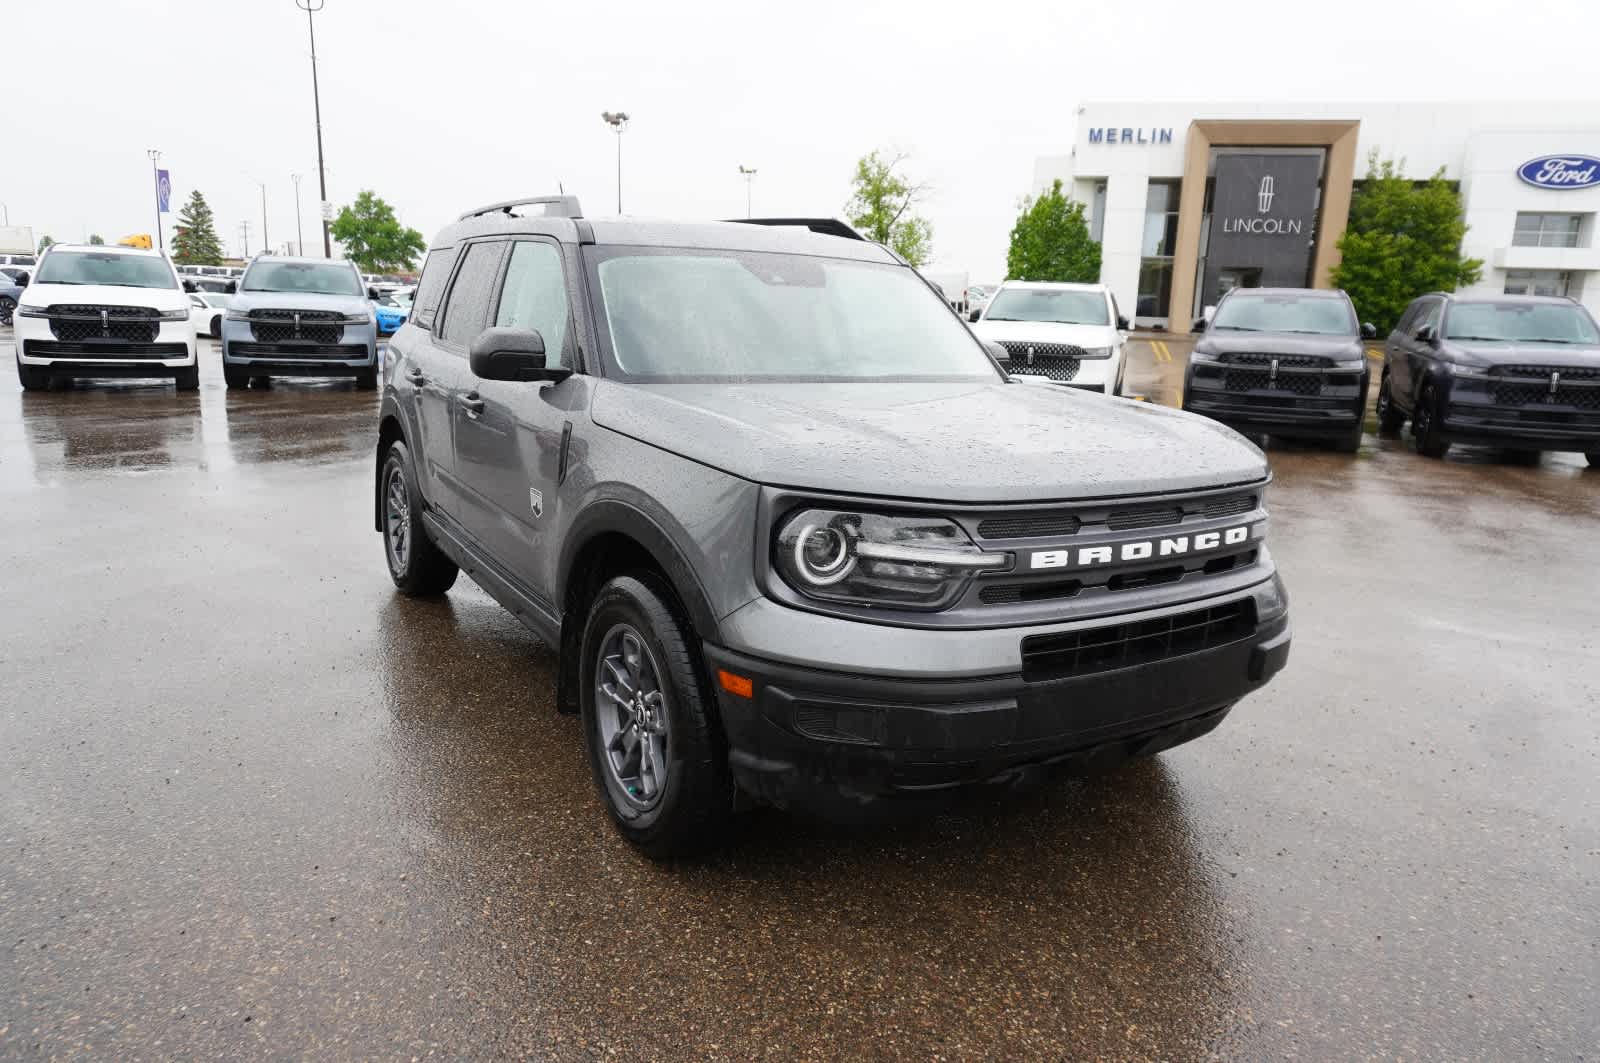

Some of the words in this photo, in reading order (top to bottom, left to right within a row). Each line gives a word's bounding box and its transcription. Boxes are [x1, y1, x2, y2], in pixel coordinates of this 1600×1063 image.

[1089, 127, 1174, 145] MERLIN
[1536, 159, 1597, 183] Ford
[1223, 218, 1302, 234] LINCOLN
[1030, 526, 1248, 569] BRONCO
